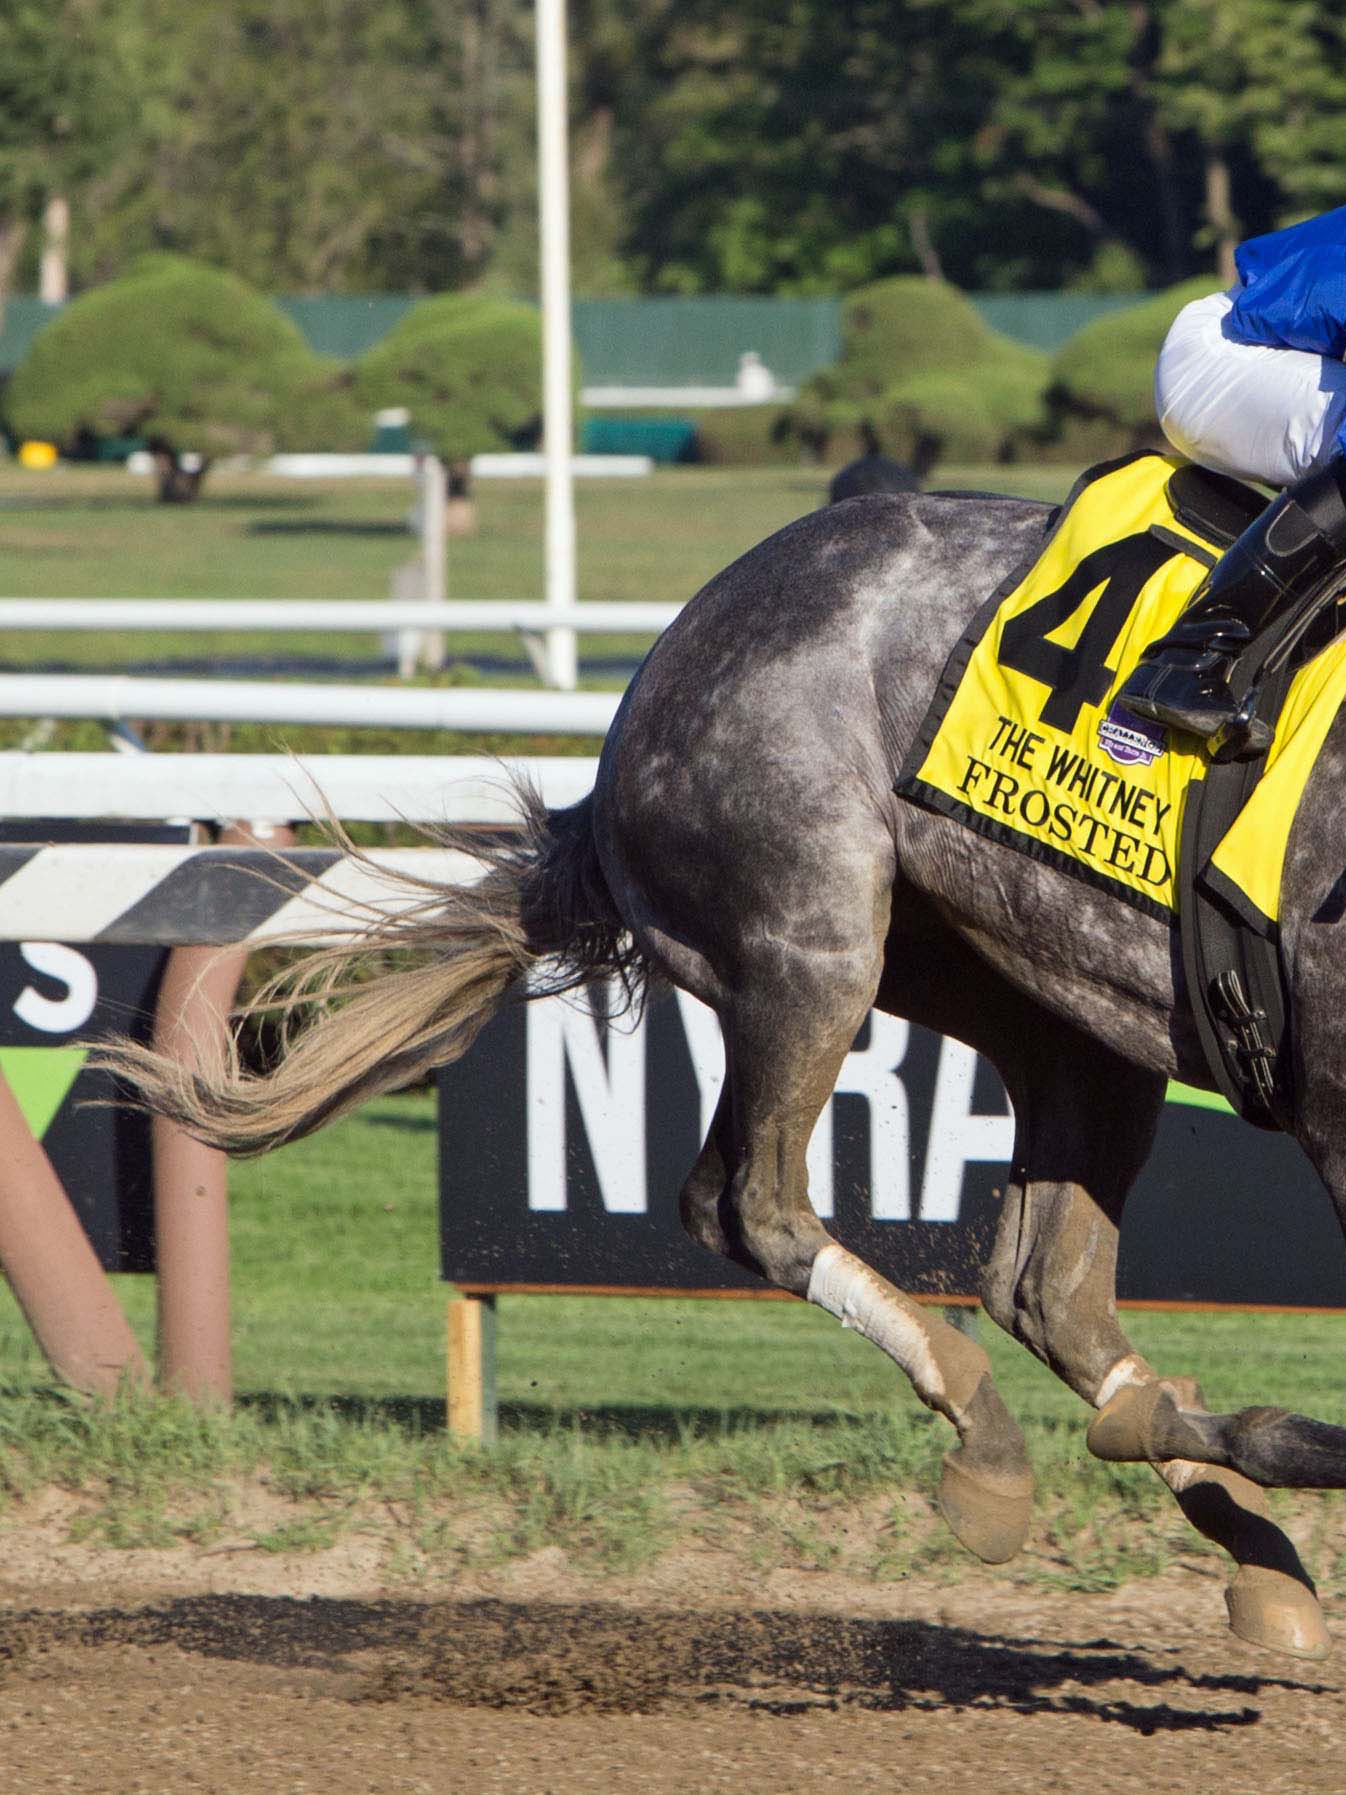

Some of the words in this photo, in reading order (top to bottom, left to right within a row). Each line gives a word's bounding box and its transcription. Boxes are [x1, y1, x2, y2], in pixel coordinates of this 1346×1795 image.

[998, 529, 1186, 735] 4
[957, 755, 1172, 886] FROSTED
[989, 715, 1046, 771] THE
[1045, 744, 1172, 836] WHITNEY
